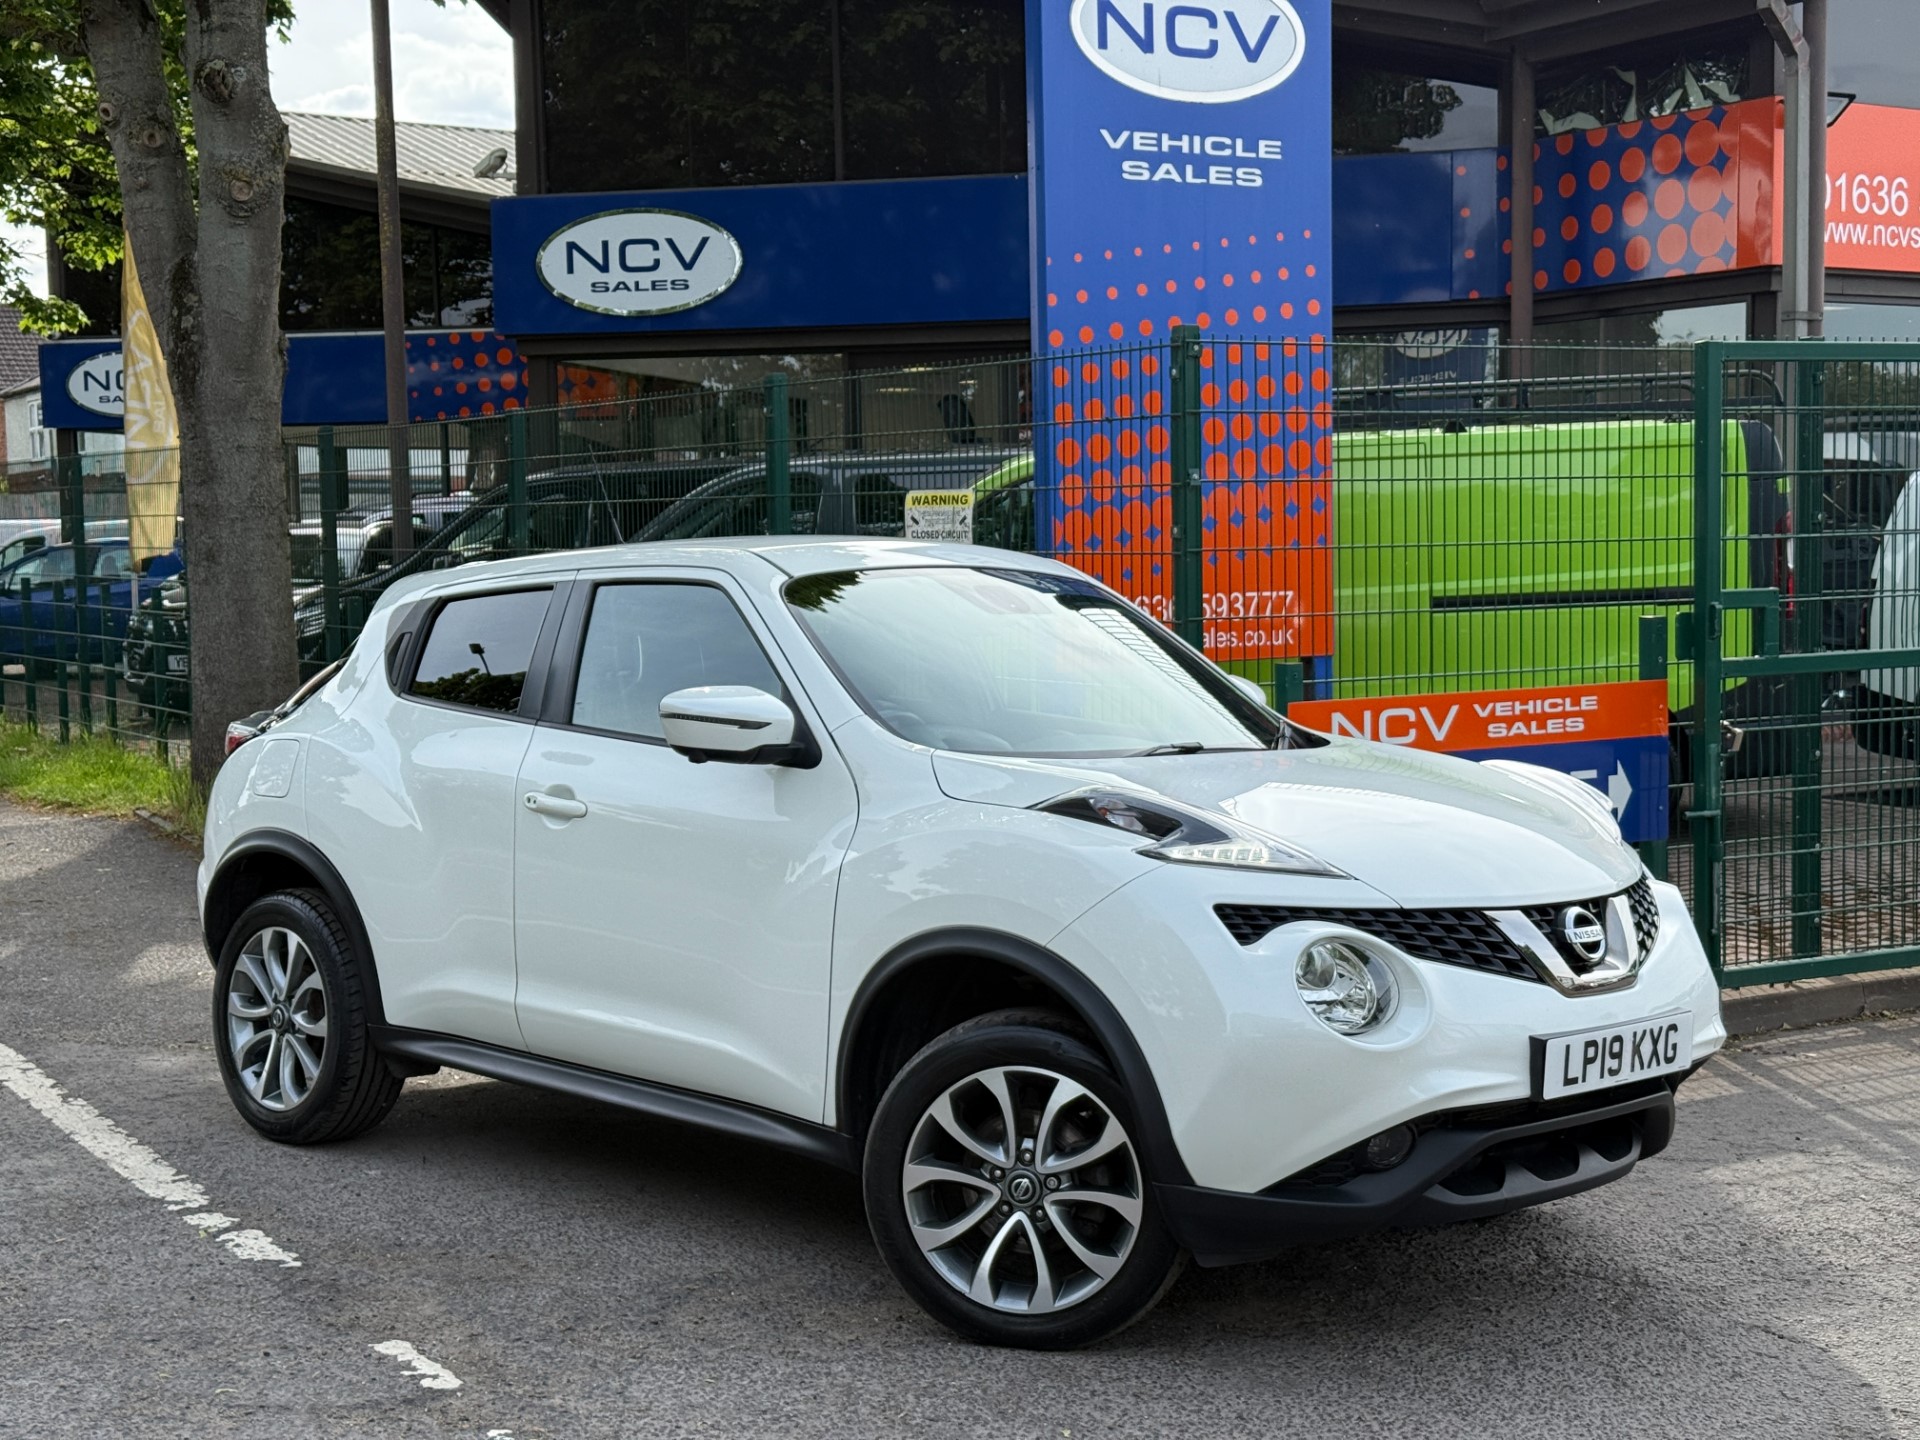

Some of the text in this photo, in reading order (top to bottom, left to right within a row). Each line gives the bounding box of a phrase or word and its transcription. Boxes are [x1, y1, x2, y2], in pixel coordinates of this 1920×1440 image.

[1097, 0, 1280, 63] NCV
[1100, 129, 1282, 160] VEHICLE
[1121, 160, 1263, 188] SALES
[566, 236, 711, 275] NCV
[590, 278, 690, 293] SALES
[911, 494, 969, 506] WARNING
[911, 530, 968, 540] CLOSED CIRCUIT
[1331, 696, 1598, 744] NCV VEHICLE
[1487, 717, 1585, 738] SALES
[1563, 1023, 1679, 1087] LP19 KXG
